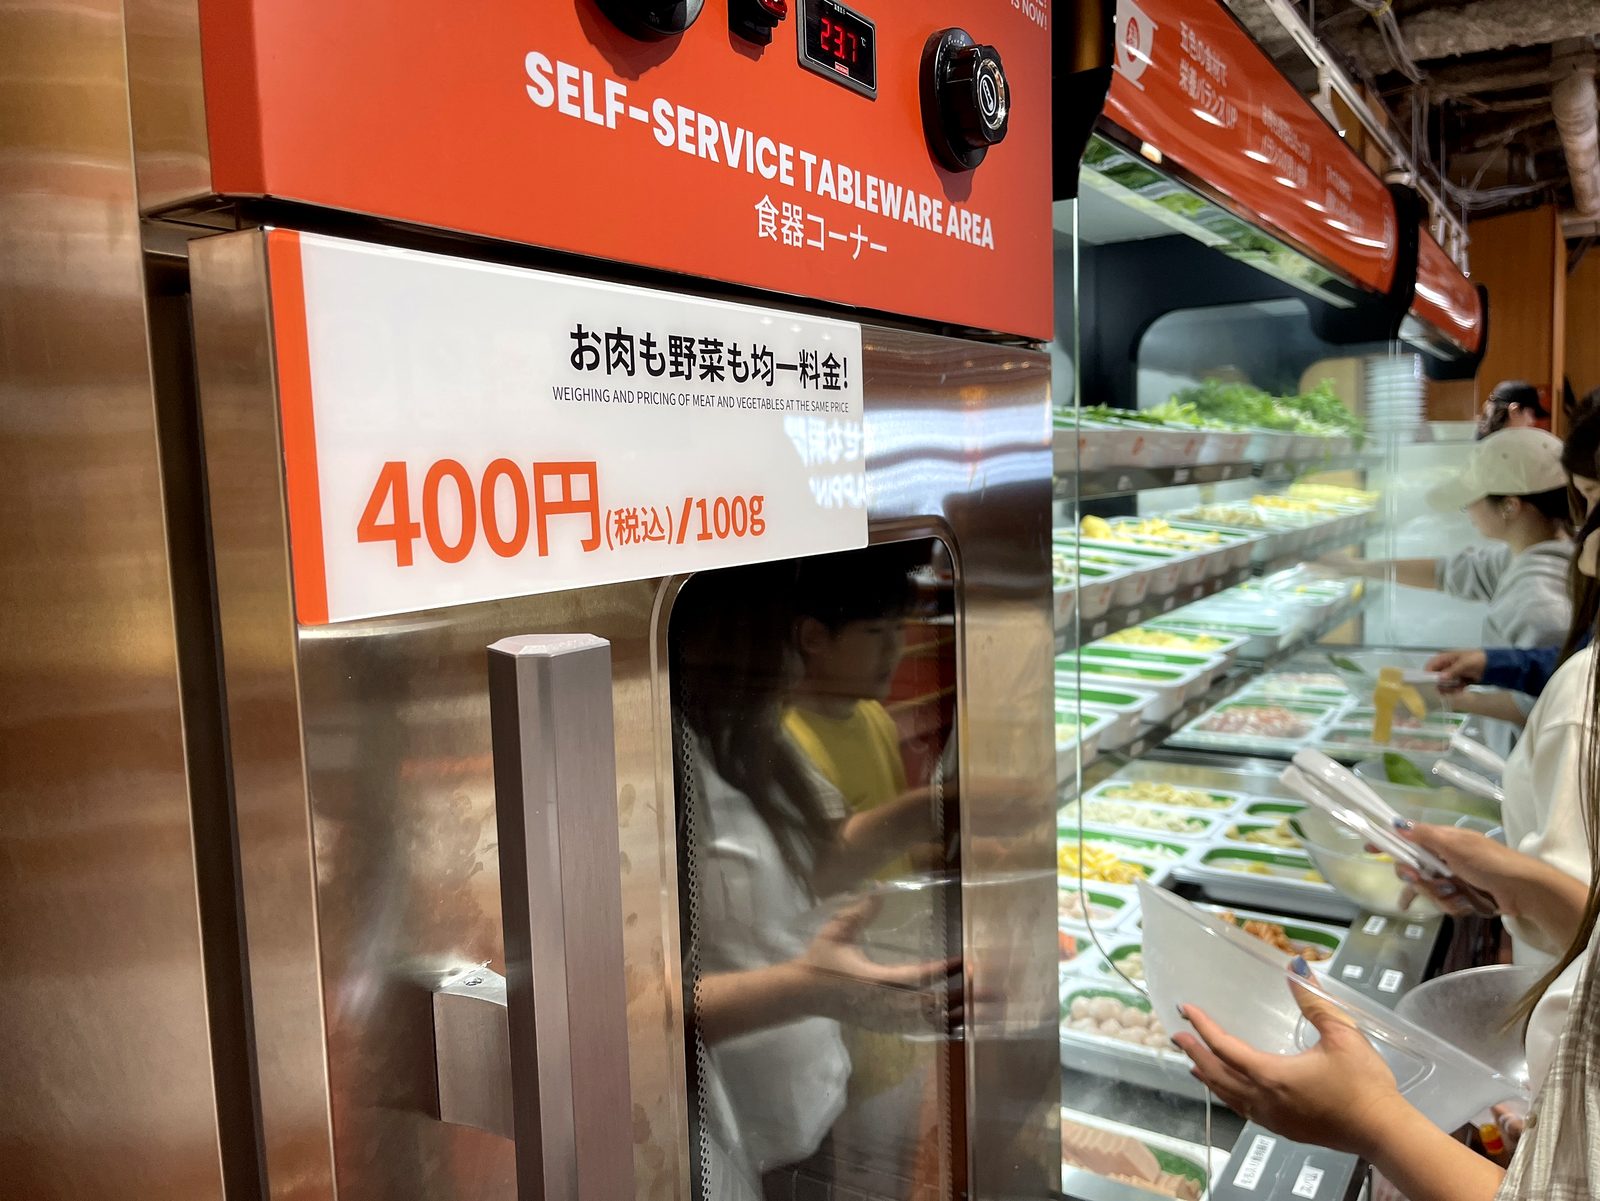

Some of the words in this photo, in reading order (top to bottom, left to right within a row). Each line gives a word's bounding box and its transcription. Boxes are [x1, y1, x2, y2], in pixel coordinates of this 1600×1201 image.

[525, 51, 794, 185] SELF-SERVICE
[799, 154, 943, 233] TABLEWARE
[946, 205, 994, 250] AREA
[754, 194, 888, 260] 食器コーナー
[569, 323, 849, 391] お肉も野菜も均一料金!
[552, 387, 610, 402] WEIGHING
[613, 390, 634, 404] AND
[637, 391, 676, 406] PRICING
[678, 393, 690, 406] OF
[692, 394, 715, 407] MEAT
[717, 396, 734, 408] AND
[736, 397, 784, 410] VEGETABLES
[786, 400, 794, 410] AT
[796, 400, 809, 411] THE
[811, 401, 829, 412] SAME
[831, 402, 848, 413] PRICE
